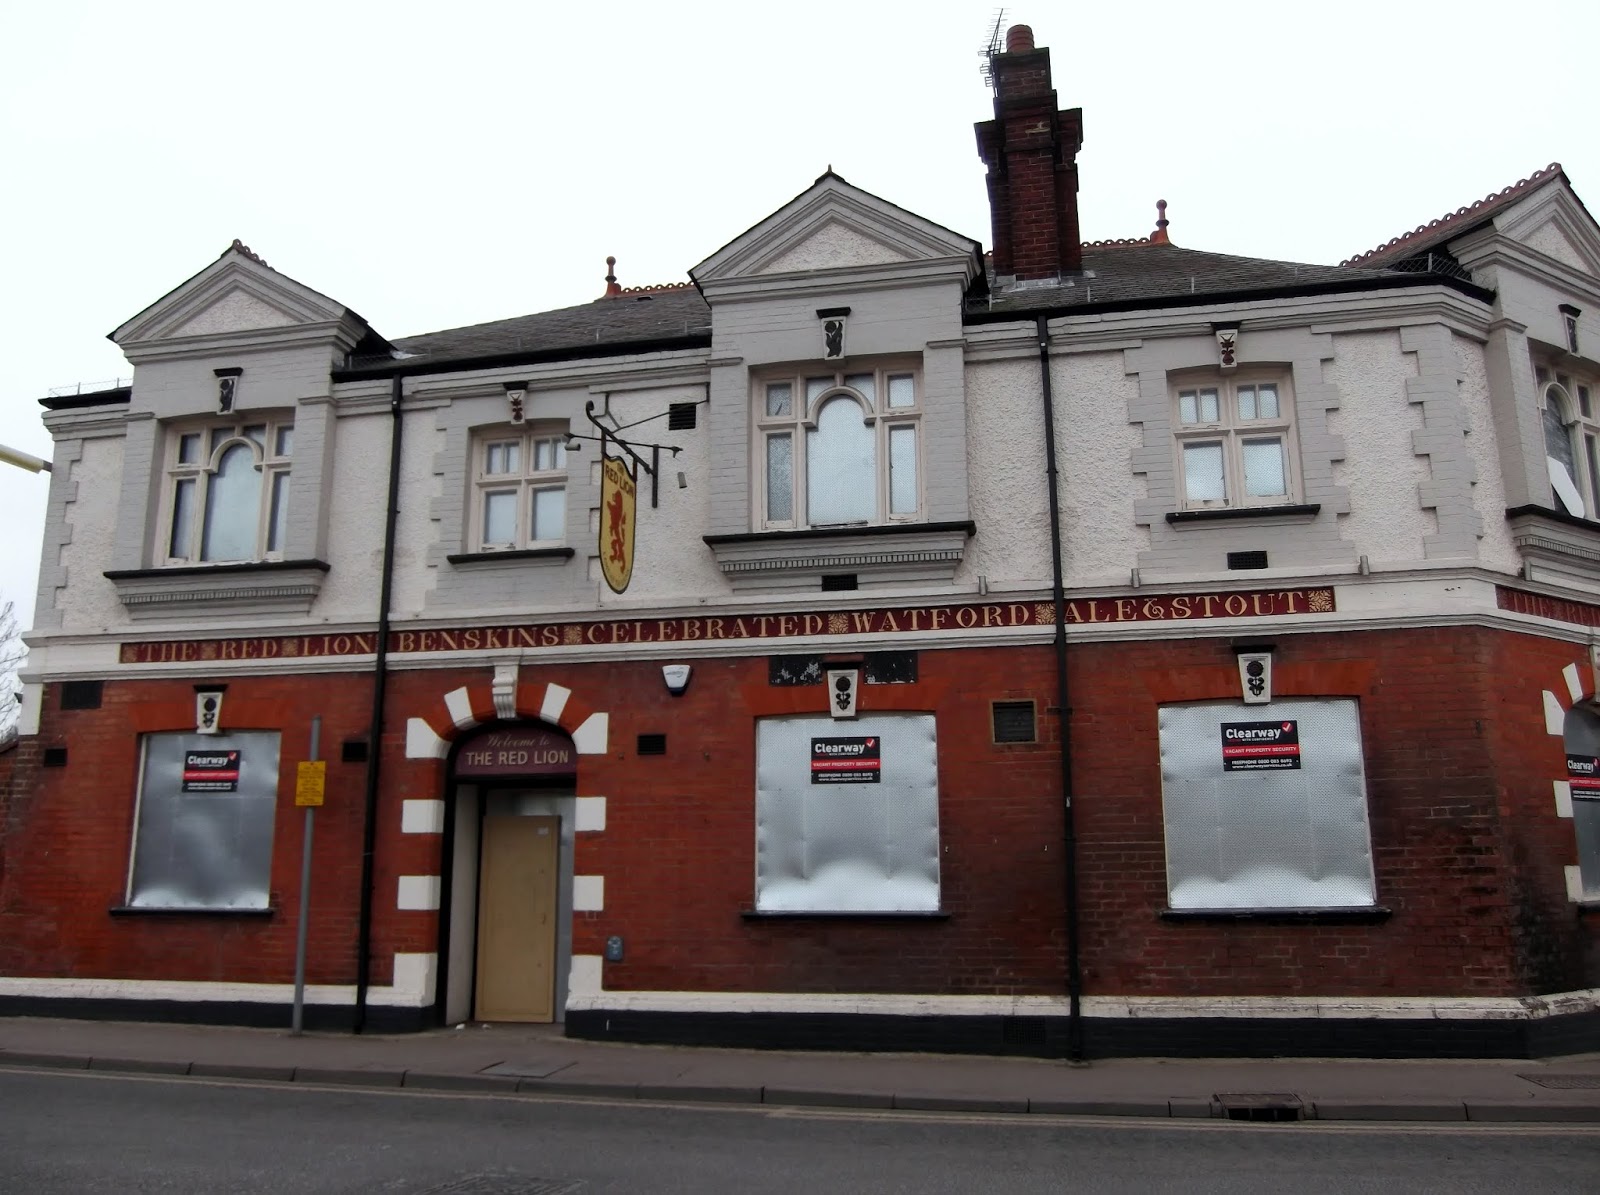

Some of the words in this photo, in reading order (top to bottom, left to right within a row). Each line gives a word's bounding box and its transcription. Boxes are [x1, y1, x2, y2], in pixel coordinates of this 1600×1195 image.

[605, 464, 619, 485] RED
[619, 475, 634, 499] LION
[397, 626, 560, 653] BENSKINS
[586, 614, 824, 644] CELEBRATED
[851, 604, 1030, 633] WATFORD
[141, 642, 198, 662] THE
[220, 638, 278, 660] RED
[302, 633, 374, 657] LION
[486, 733, 537, 747] Welcome
[539, 734, 550, 746] to
[1225, 728, 1281, 739] Clearway
[814, 743, 866, 754] Clearway
[187, 755, 229, 766] Clearway
[465, 751, 493, 766] THE
[498, 750, 528, 765] RED
[534, 749, 569, 764] LION
[1567, 759, 1594, 773] Clearway
